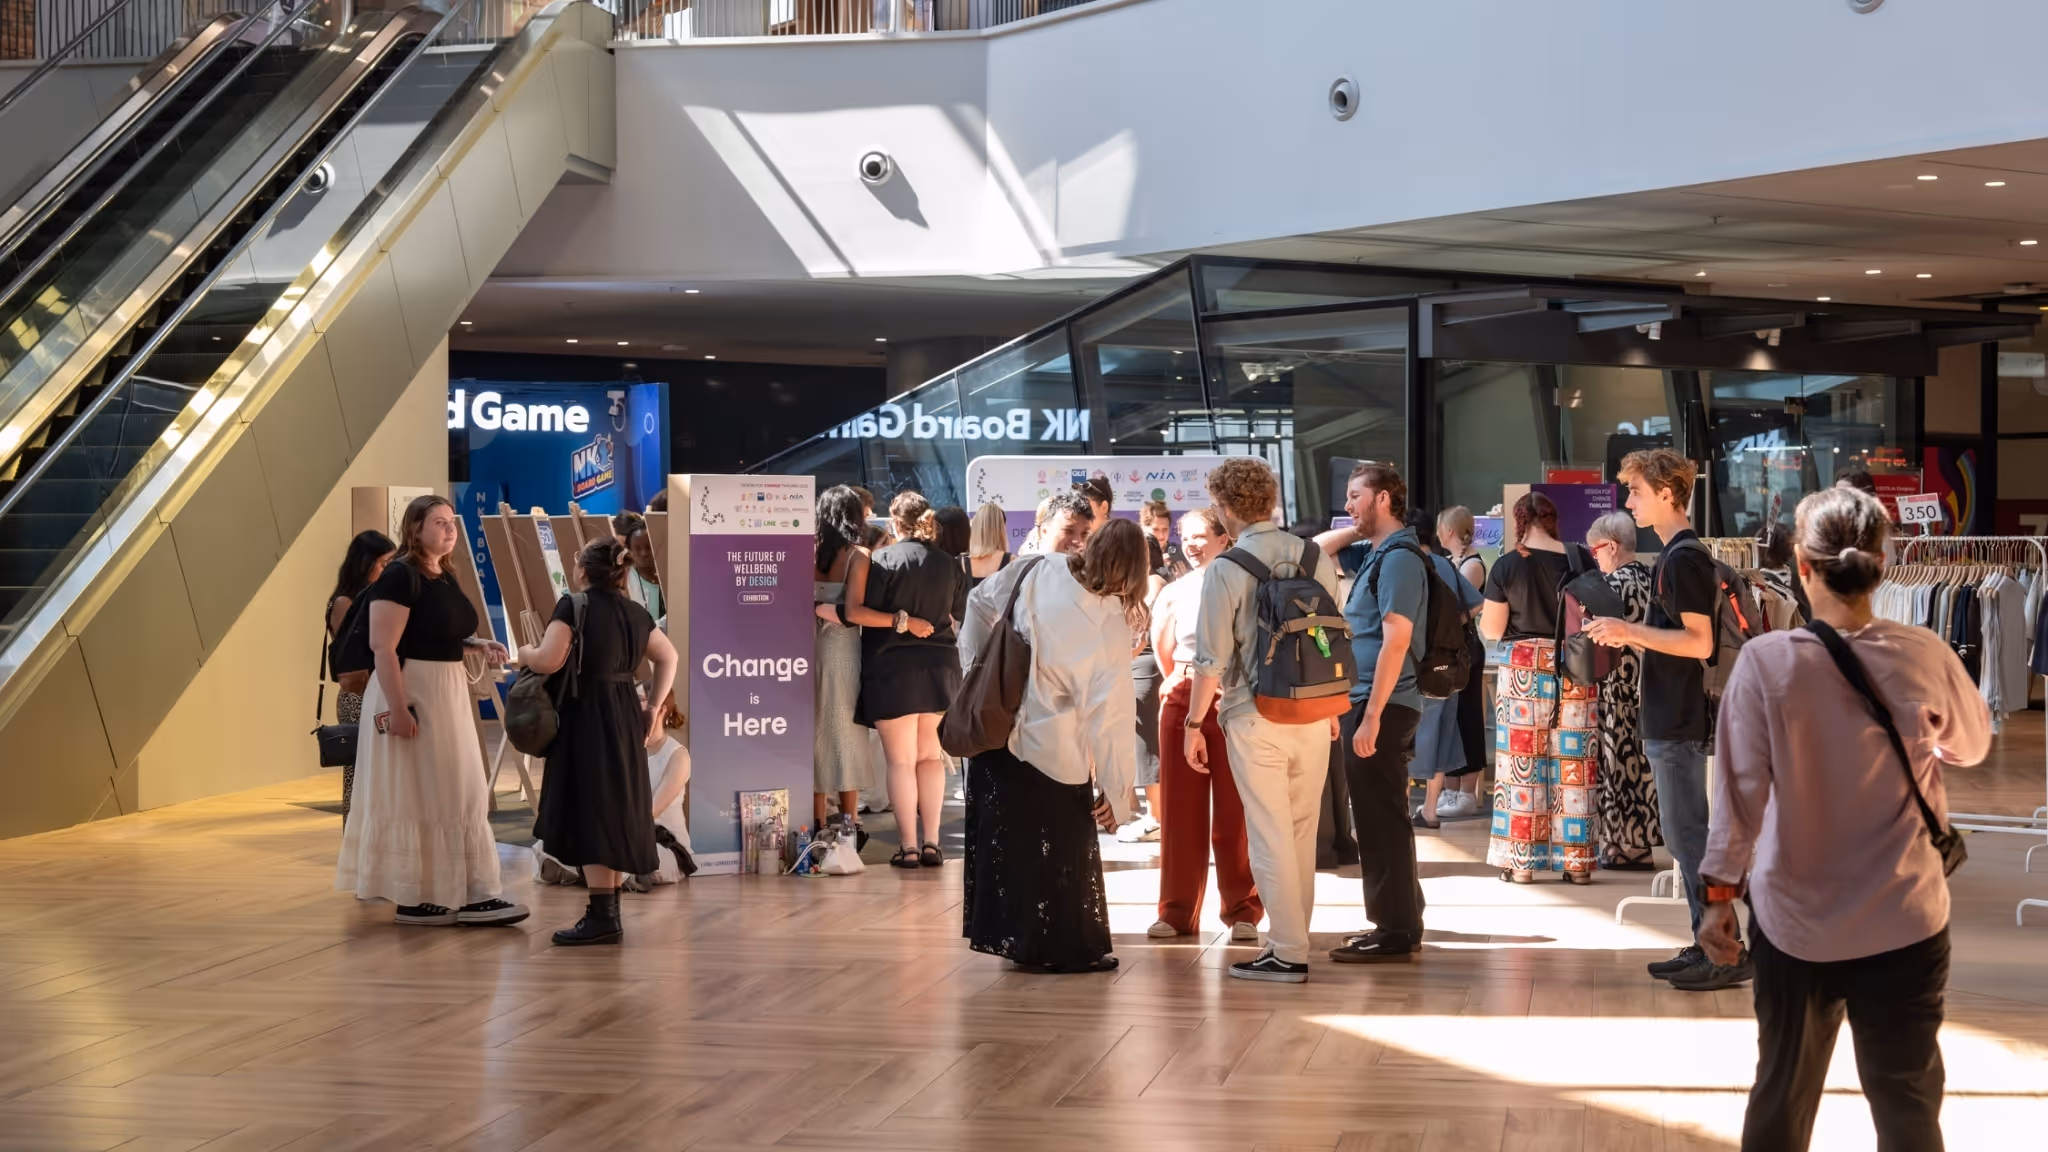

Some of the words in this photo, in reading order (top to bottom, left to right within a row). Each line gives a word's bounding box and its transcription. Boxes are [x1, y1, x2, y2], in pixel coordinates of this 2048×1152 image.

[471, 391, 590, 432] Game
[574, 445, 599, 479] NK
[577, 476, 597, 492] BOARD
[597, 470, 613, 484] GAME
[1904, 505, 1937, 521] 350
[727, 551, 741, 562] THE
[745, 551, 775, 562] FUTURE
[776, 551, 786, 562] OF
[734, 563, 777, 574] WELLBEING
[736, 576, 746, 586] BY
[749, 576, 778, 586] DESIGN
[743, 594, 769, 602] EXHIBITION
[702, 653, 808, 681] Change
[749, 692, 760, 704] is
[723, 712, 787, 736] Here
